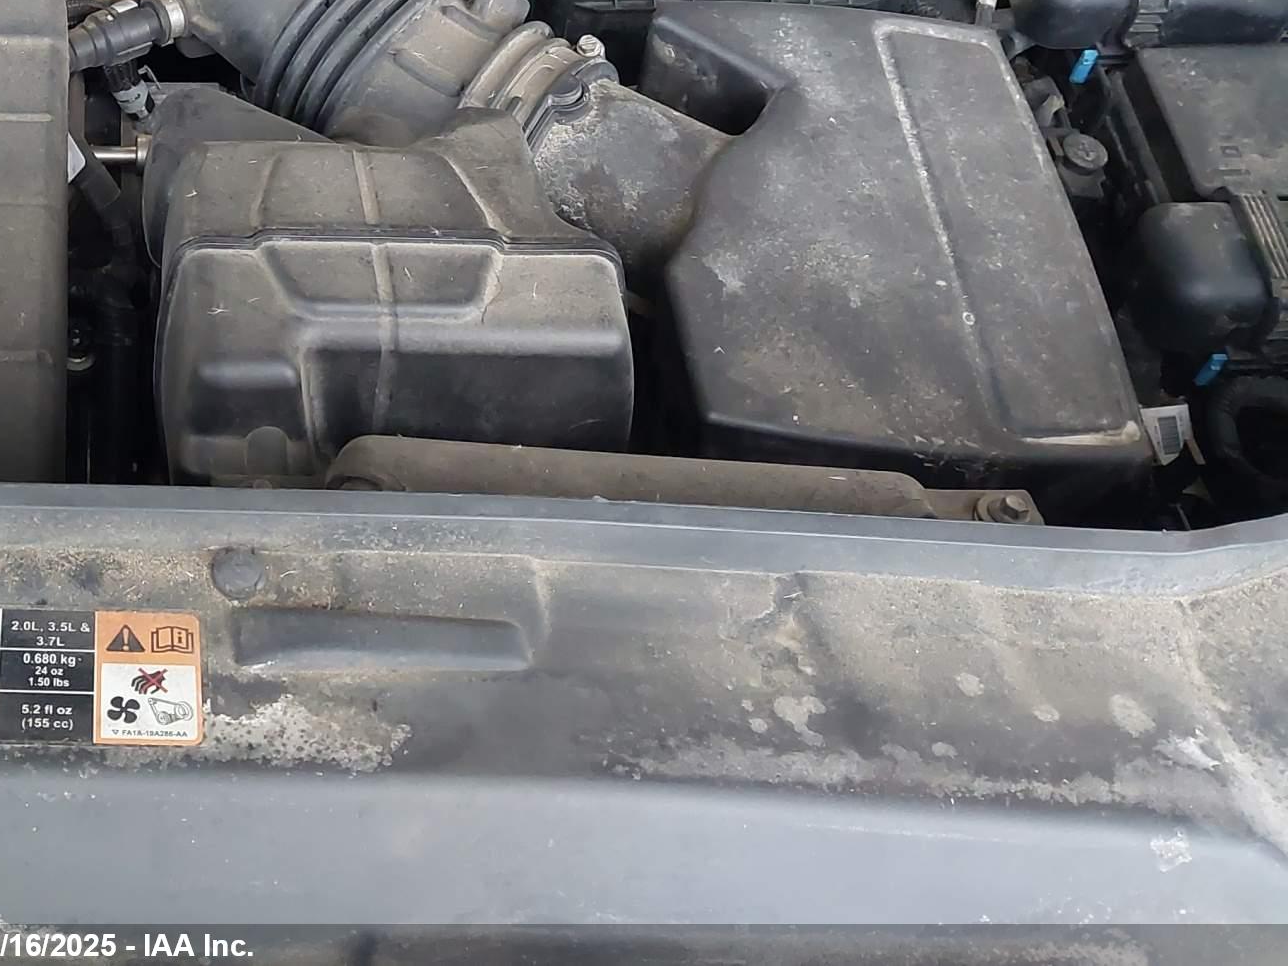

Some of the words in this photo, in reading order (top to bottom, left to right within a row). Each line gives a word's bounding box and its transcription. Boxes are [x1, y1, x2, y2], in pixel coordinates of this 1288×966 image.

[11, 620, 44, 633] 2.0L,
[47, 621, 76, 633] 3.5L
[80, 622, 90, 633] &
[36, 636, 65, 647] 3.7L
[23, 653, 57, 664] 0.680
[60, 654, 76, 667] kg
[35, 666, 49, 675] 24
[28, 677, 50, 687] 1.50
[52, 677, 70, 687] lbs
[21, 705, 41, 715] 5.2
[44, 705, 53, 715] fl
[56, 706, 73, 715] oz
[21, 718, 50, 730] (155
[53, 719, 74, 730] cc)
